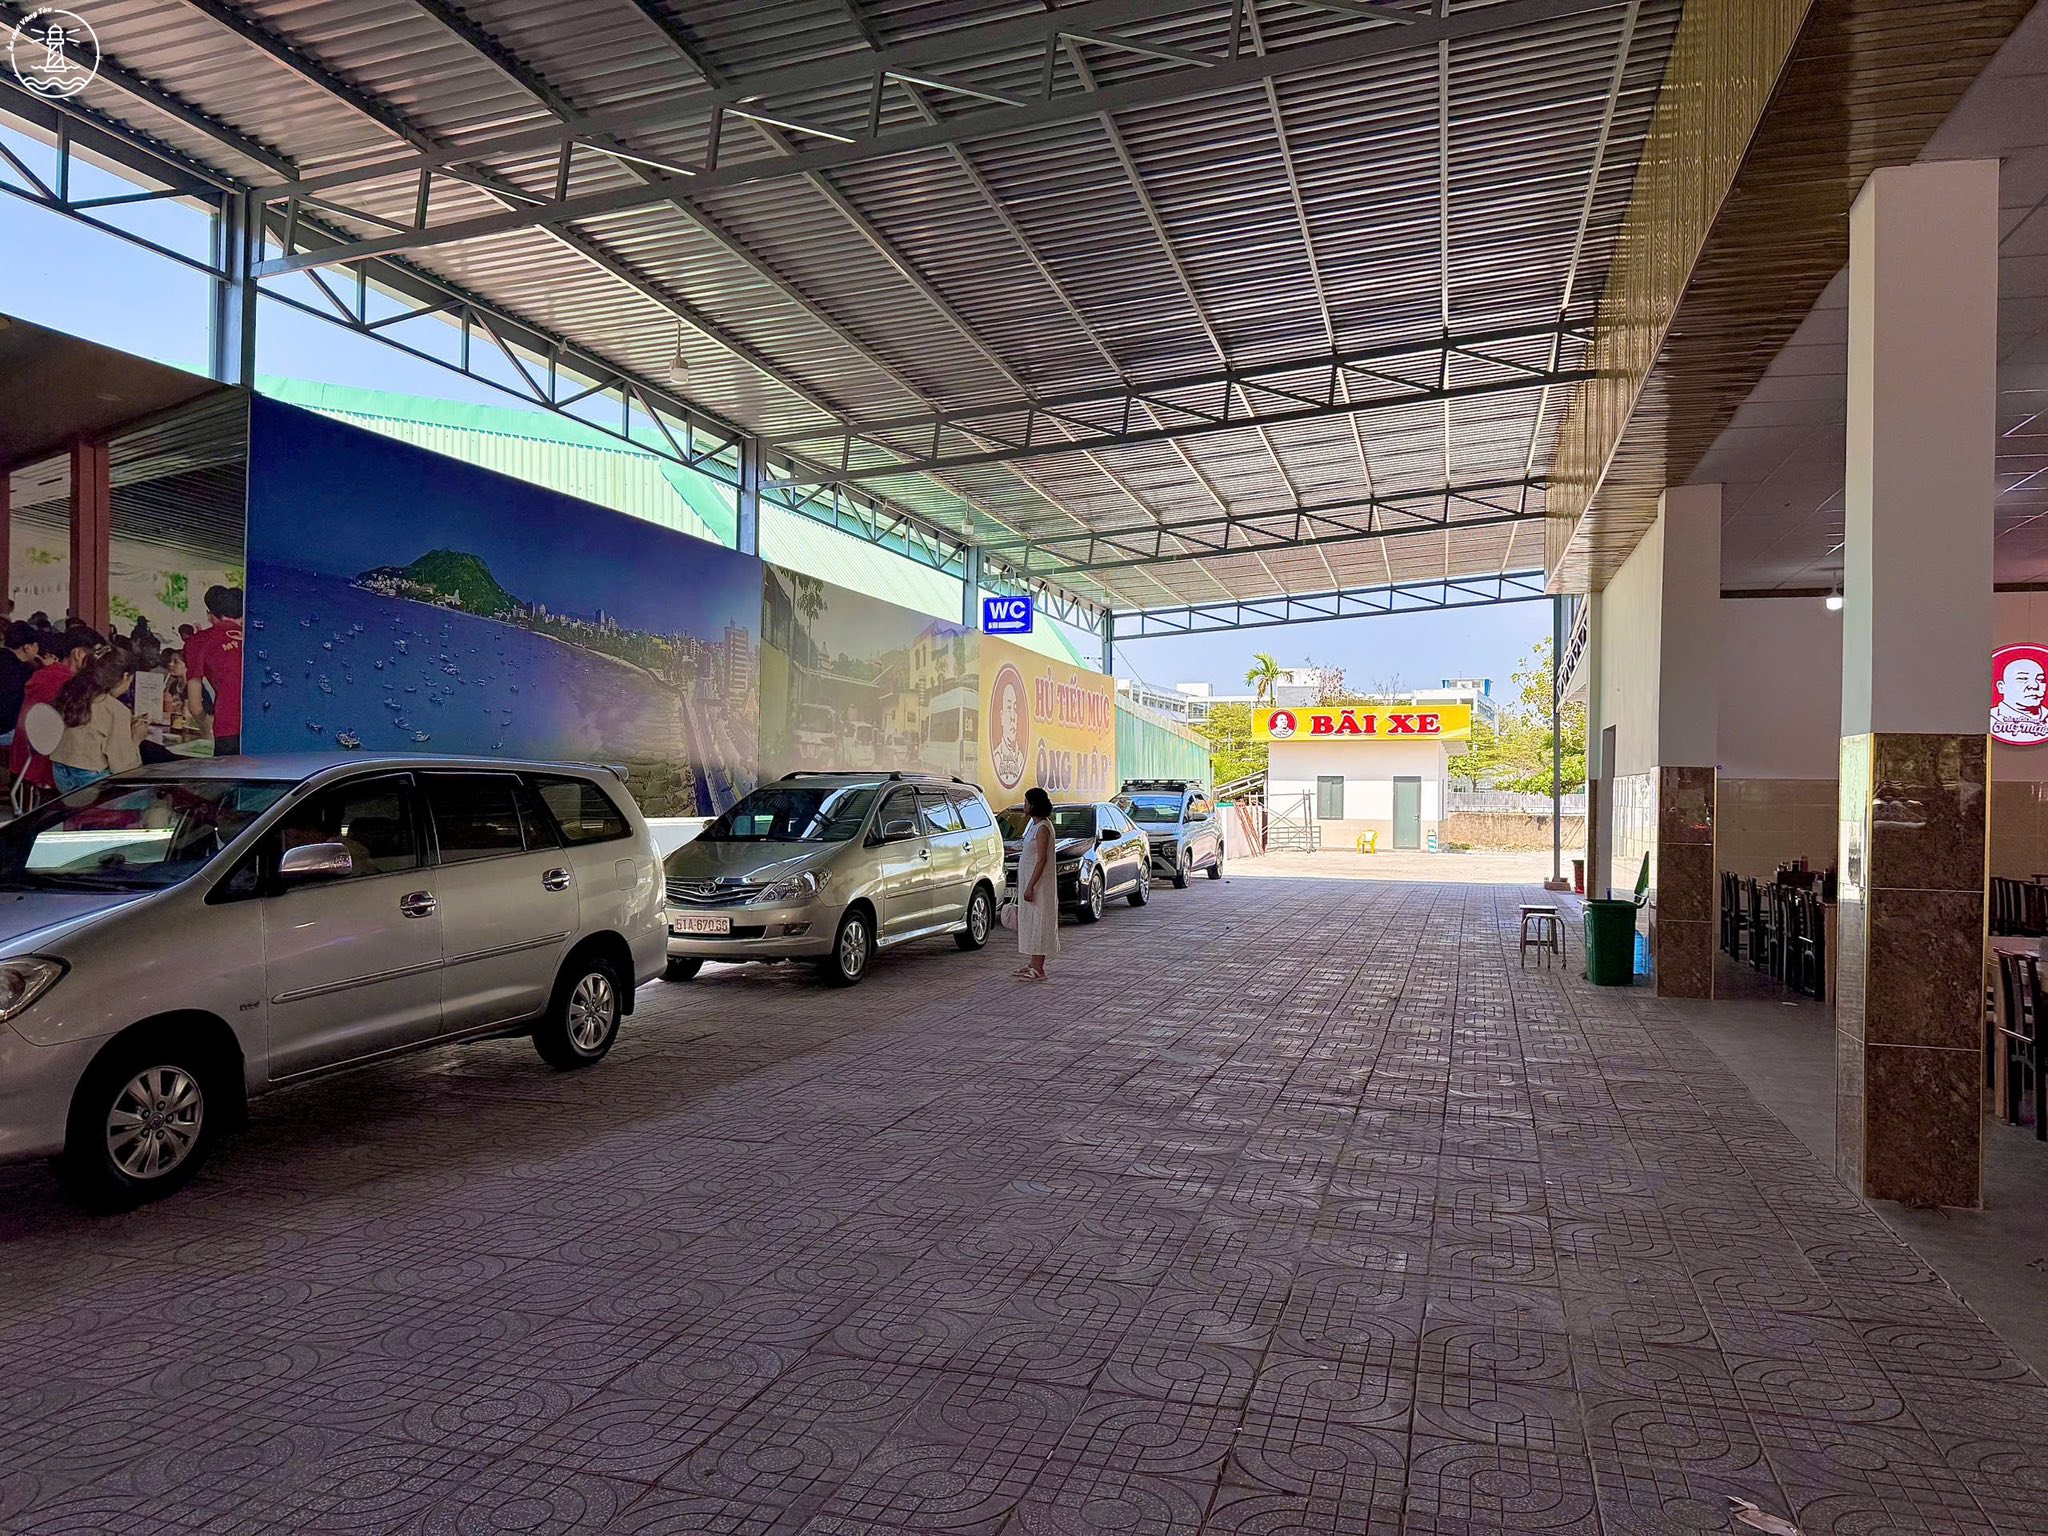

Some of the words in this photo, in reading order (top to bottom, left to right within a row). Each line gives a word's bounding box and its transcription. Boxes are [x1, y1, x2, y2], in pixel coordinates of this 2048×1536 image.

[989, 601, 1026, 619] WC
[1034, 665, 1055, 721] HỦ
[1057, 673, 1086, 726] TIẾU
[1086, 686, 1111, 737] MỰC
[1310, 710, 1377, 735] BÃI
[1387, 713, 1440, 734] XE
[1036, 737, 1072, 791] ÔNG
[1076, 744, 1109, 794] MẬP
